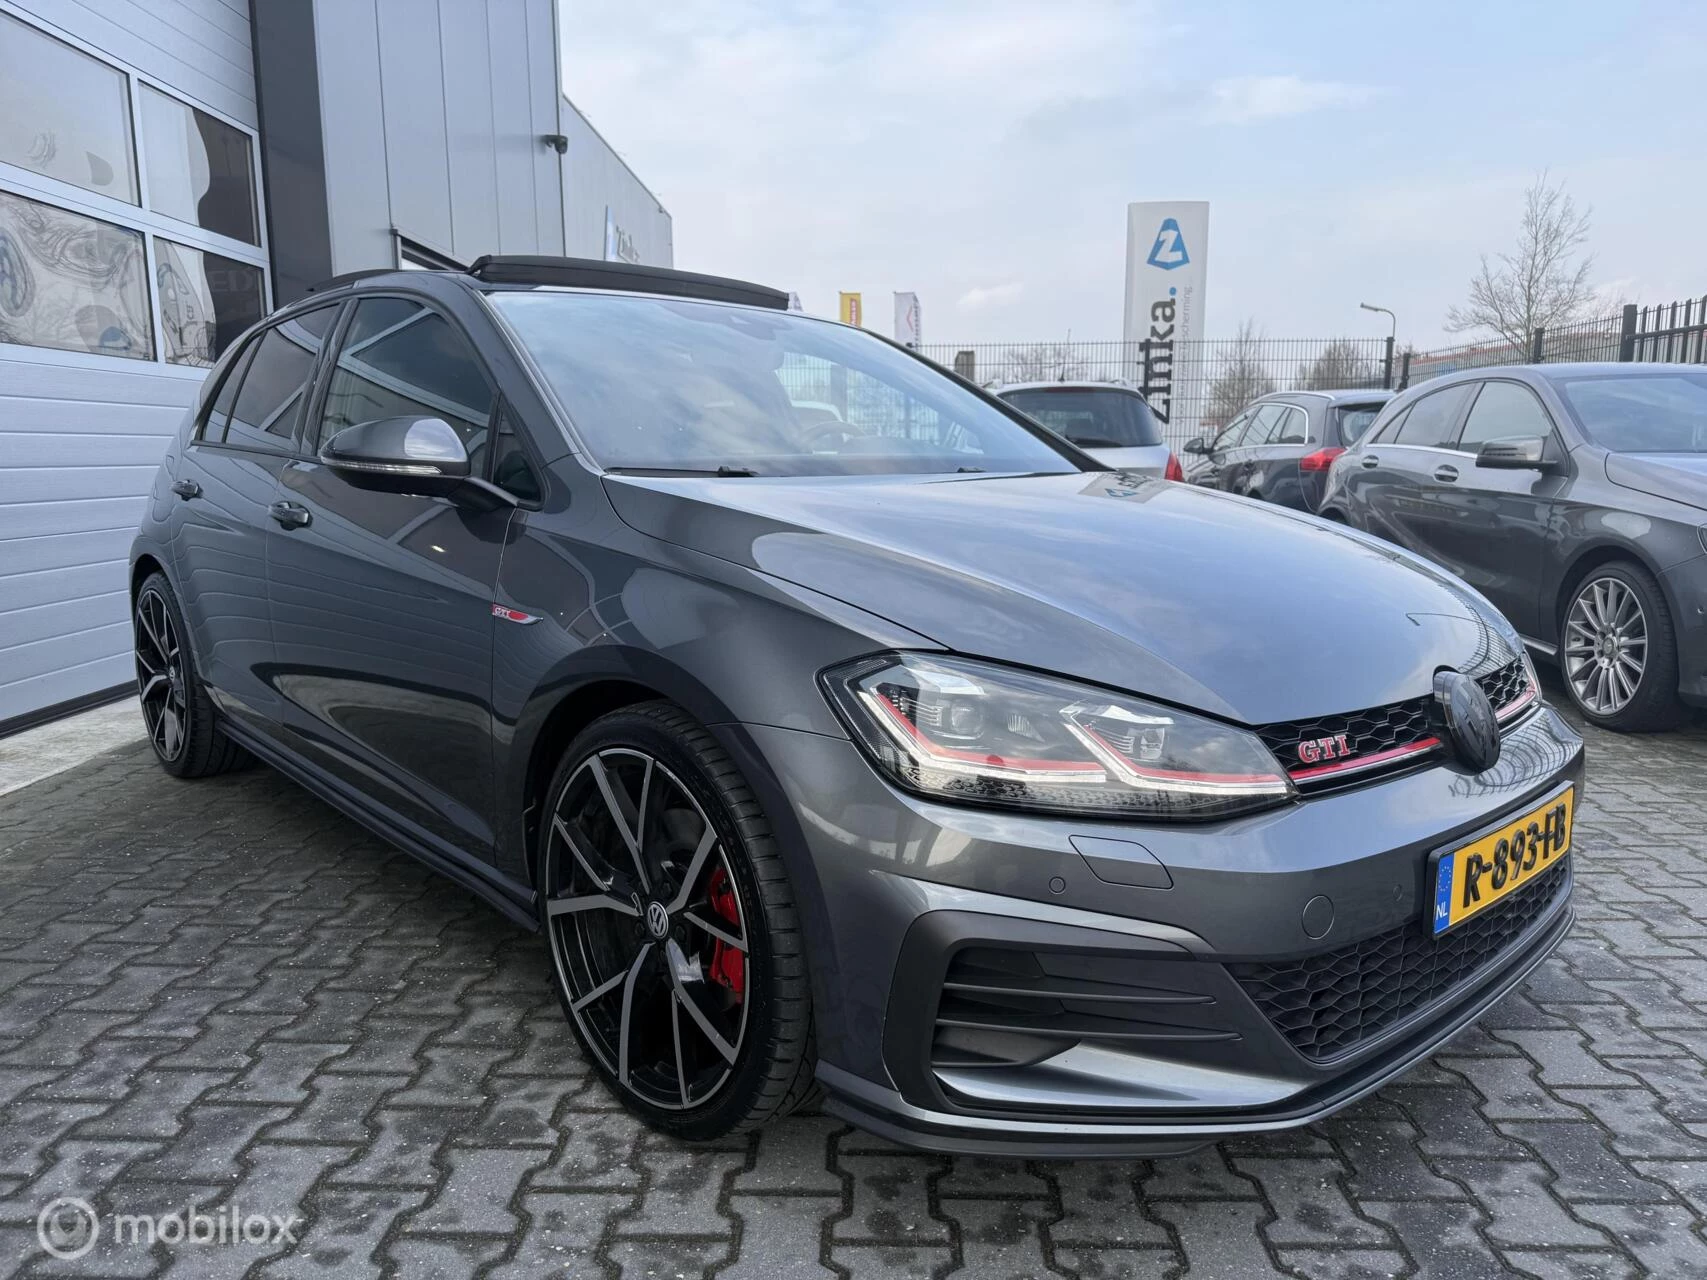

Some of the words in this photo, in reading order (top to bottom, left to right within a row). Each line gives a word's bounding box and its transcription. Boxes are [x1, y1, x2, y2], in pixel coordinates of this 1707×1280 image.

[1298, 734, 1351, 764] GTI
[1463, 802, 1566, 908] R-893-FB
[1435, 904, 1448, 921] NL
